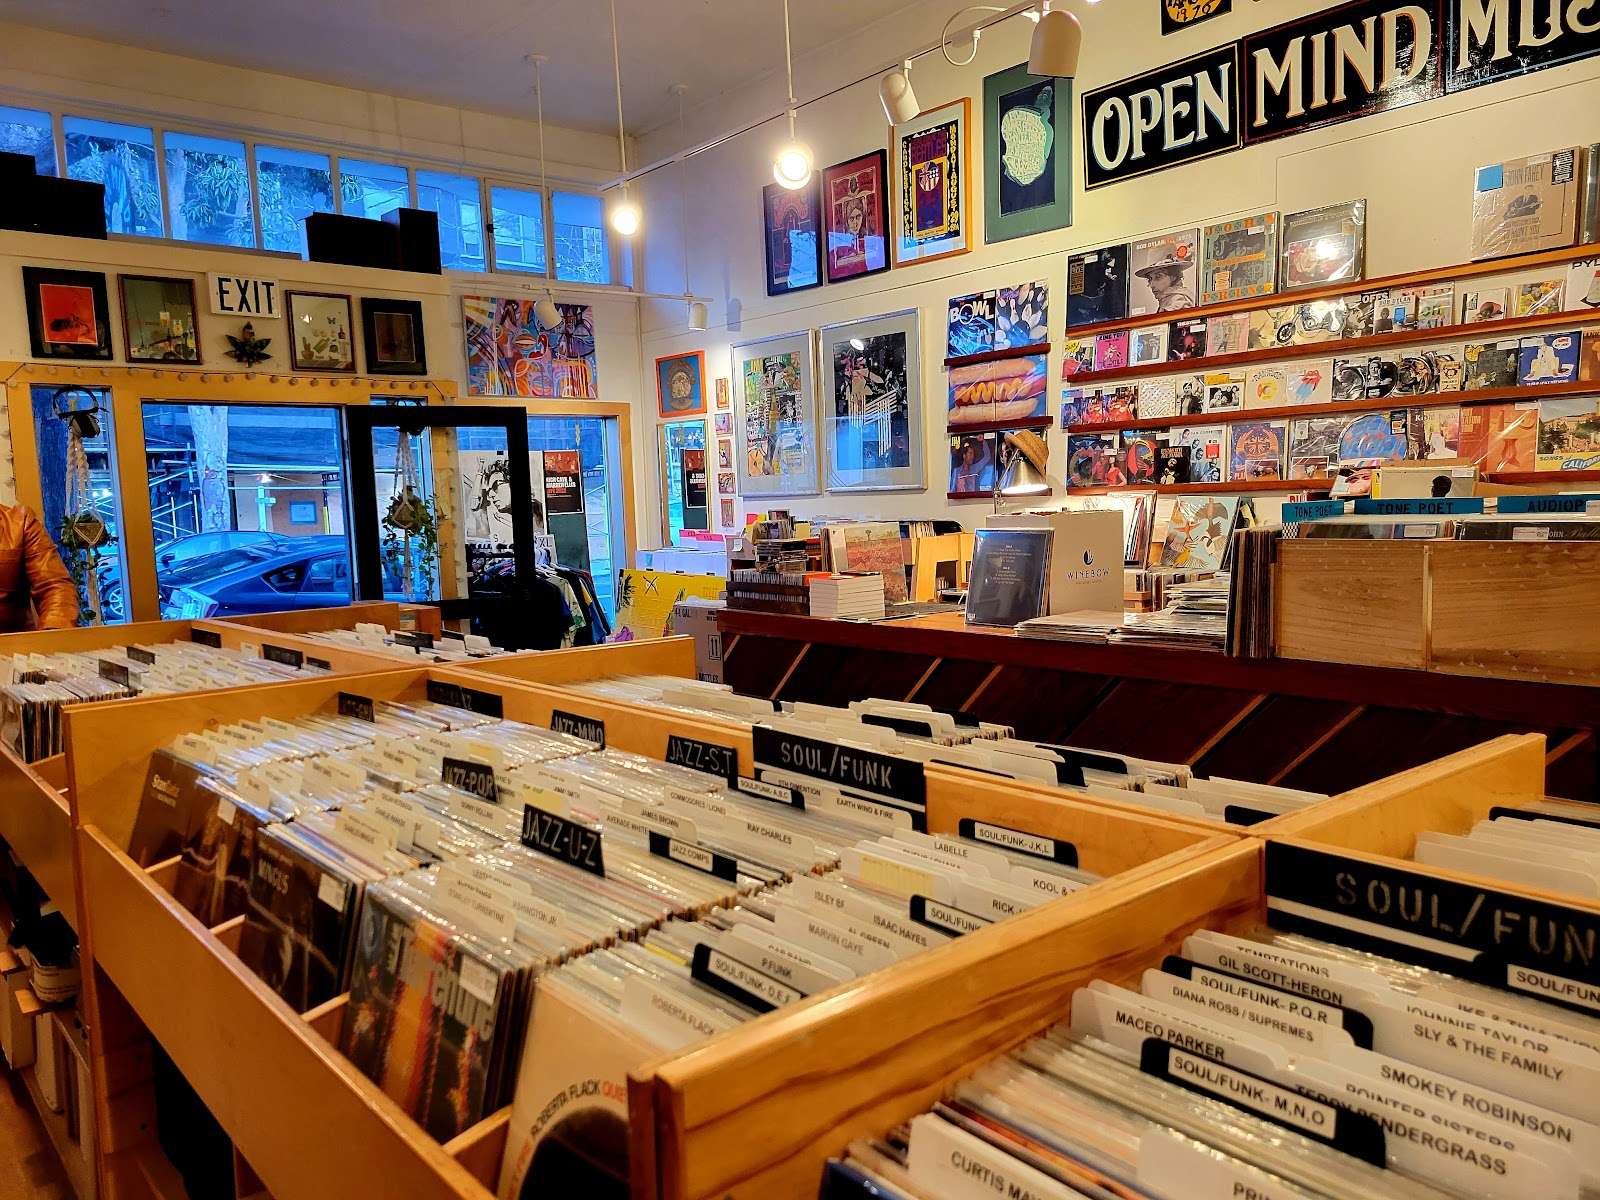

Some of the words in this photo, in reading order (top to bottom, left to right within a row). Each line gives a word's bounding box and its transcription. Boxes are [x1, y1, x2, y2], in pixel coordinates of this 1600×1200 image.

[1092, 62, 1231, 171] OPEN
[1252, 6, 1433, 127] MIND
[217, 277, 275, 314] EXIT
[949, 301, 994, 325] BOWL
[1377, 503, 1410, 514] TONE
[1418, 502, 1454, 514] POET
[781, 742, 893, 788] SOUL/FUNK
[658, 813, 679, 828] BROWN
[836, 797, 857, 809] EARTH
[857, 802, 872, 811] WIND
[879, 809, 894, 820] FIRE
[747, 822, 759, 834] RAY
[760, 826, 792, 846] CHARLES
[671, 843, 687, 858] JAZZ
[934, 842, 968, 857] LABELLE
[1033, 878, 1059, 895] KOOL
[1061, 886, 1068, 896] &
[992, 899, 1013, 914] RICK
[808, 923, 841, 945] MARVIN
[841, 938, 864, 956] GAYE
[873, 913, 898, 934] ISAAC
[898, 924, 928, 948] HAYES
[1218, 955, 1239, 971] GIL
[1243, 959, 1342, 1005] SCOTT-HERON
[688, 1016, 715, 1036] FLACK
[1172, 985, 1206, 1006] DIANA
[1208, 999, 1240, 1017] ROSS
[1248, 1009, 1315, 1043] SUPREMES
[1115, 1010, 1164, 1038] MACEO
[1167, 1029, 1225, 1061] PARKER
[1413, 1024, 1442, 1043] SLY
[1446, 1035, 1458, 1049] &
[1461, 1039, 1496, 1060] THE
[1501, 1051, 1565, 1082] FAMILY
[568, 1079, 601, 1101] FLACK
[1380, 1065, 1458, 1102] SMOKEY
[1462, 1092, 1573, 1143] ROBINSON
[951, 1151, 1004, 1193] CURTIS
